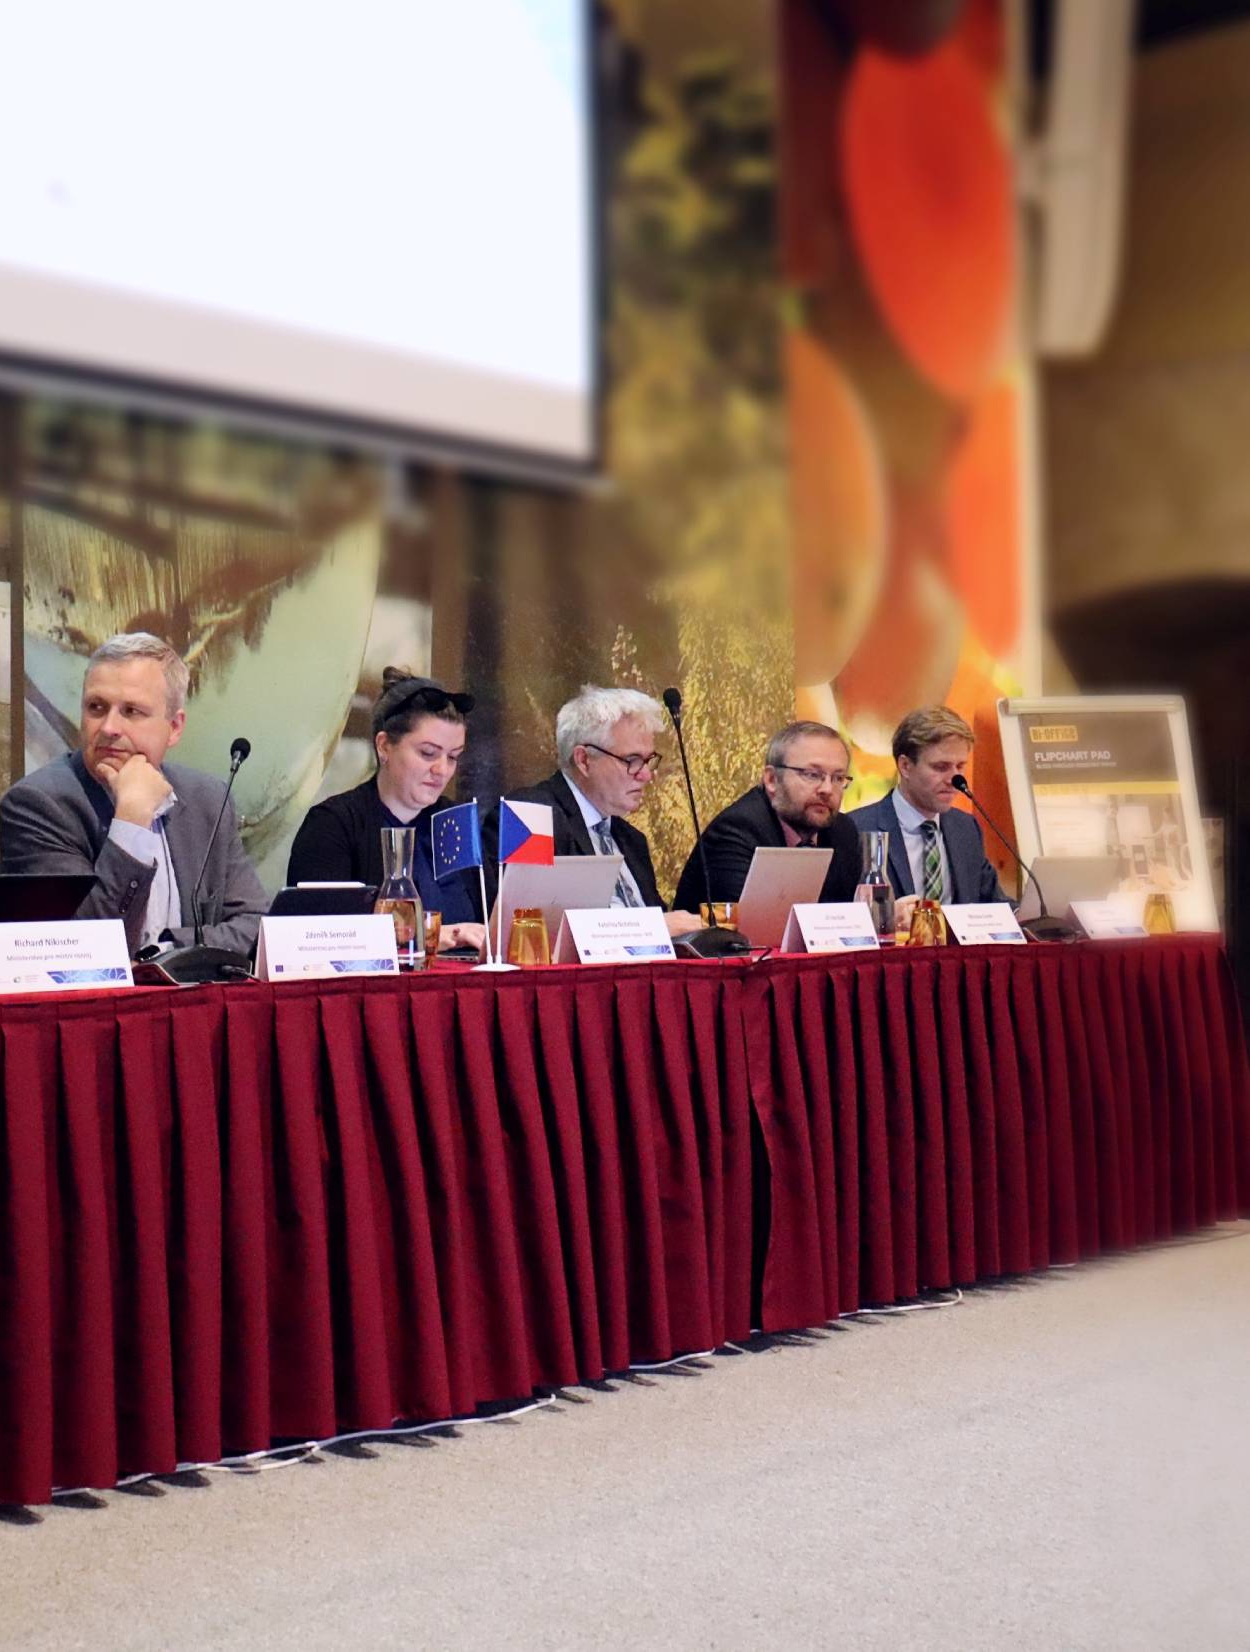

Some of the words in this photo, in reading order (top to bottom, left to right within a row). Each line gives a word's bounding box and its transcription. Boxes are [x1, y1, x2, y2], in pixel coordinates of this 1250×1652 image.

[1034, 751, 1088, 762] FLIPCHART
[1090, 750, 1111, 761] PAD
[14, 938, 44, 948] Richard
